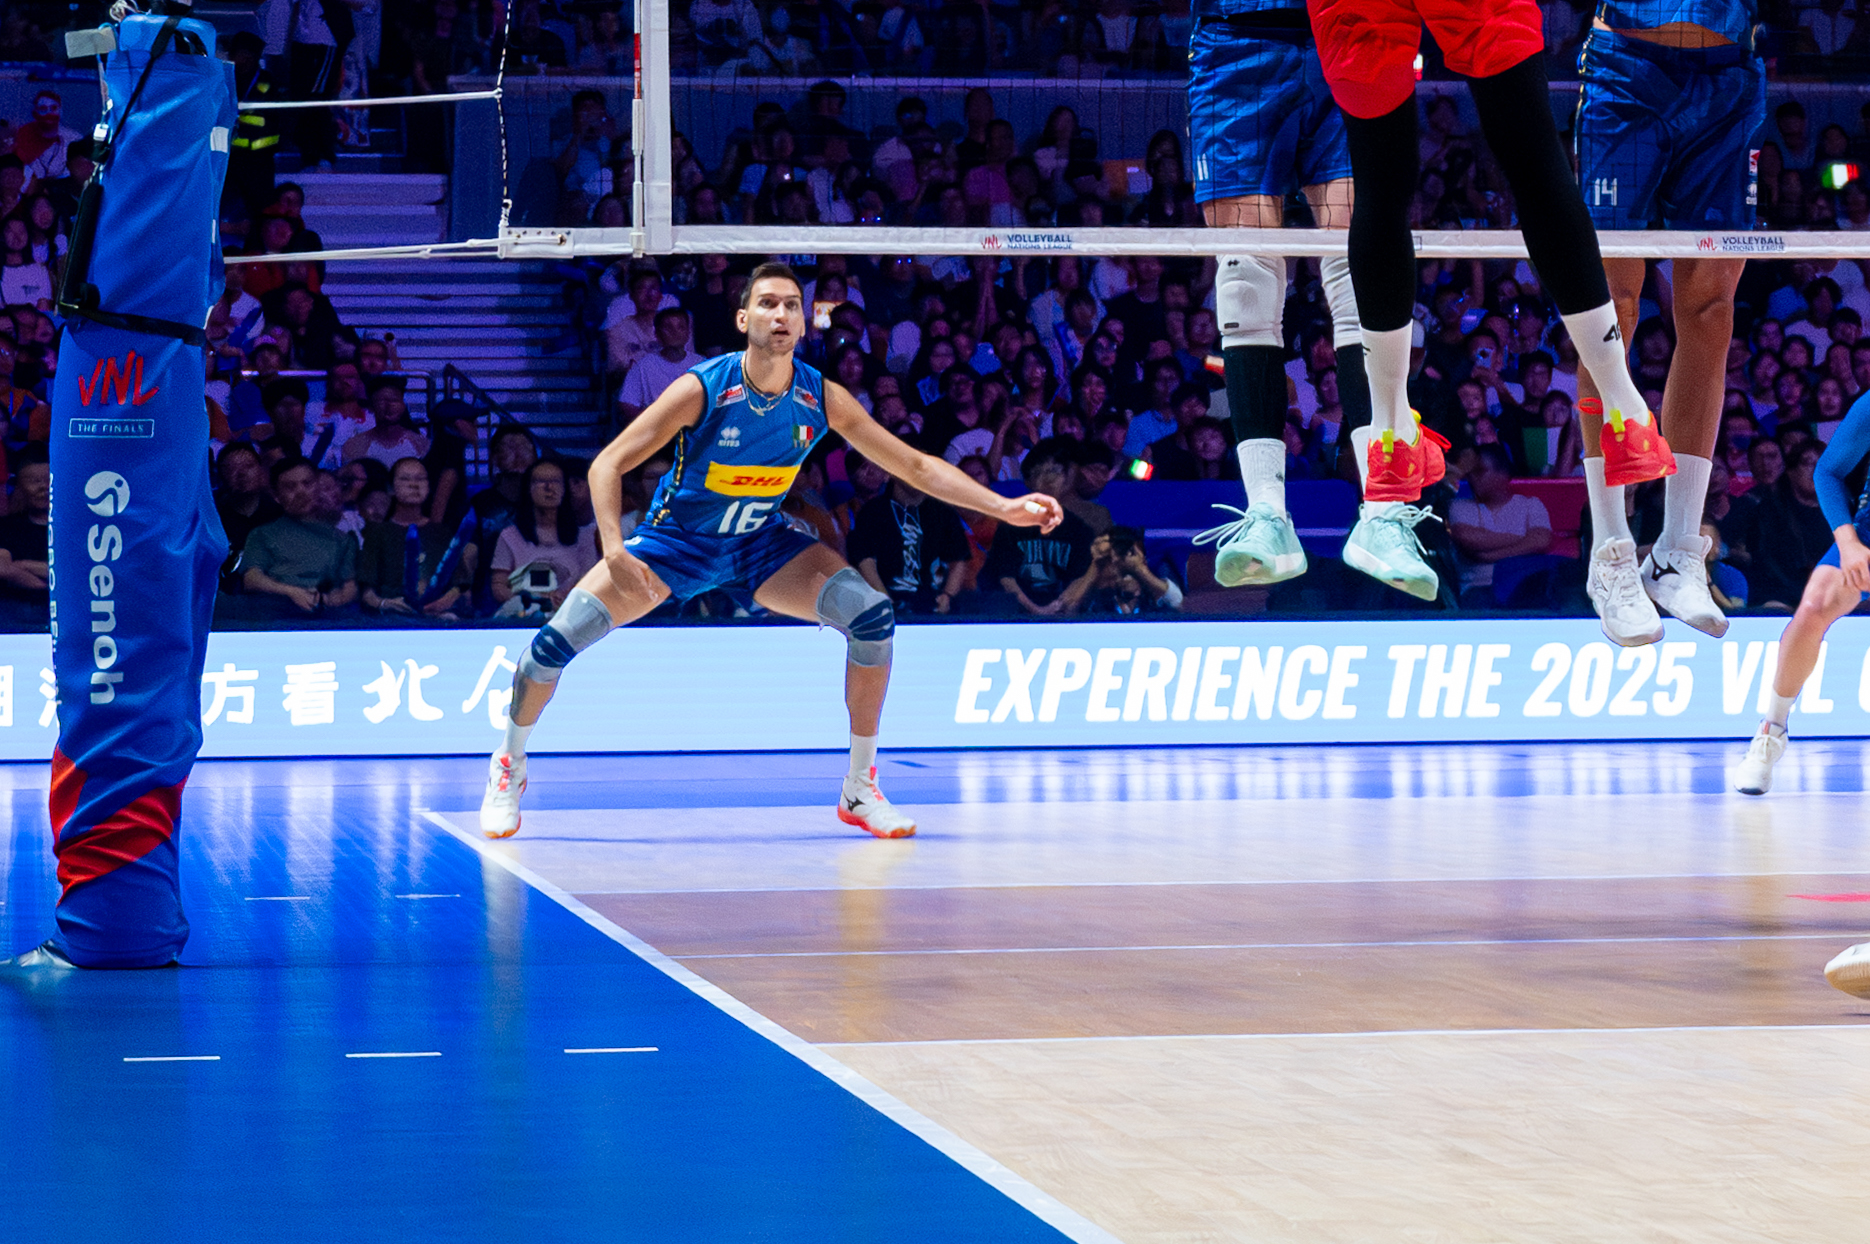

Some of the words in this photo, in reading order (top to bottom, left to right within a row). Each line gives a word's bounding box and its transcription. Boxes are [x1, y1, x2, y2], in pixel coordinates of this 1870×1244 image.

[1595, 178, 1617, 206] 14
[981, 234, 1002, 249] VNL
[1007, 234, 1072, 243] VOLLEYBALL
[1697, 236, 1718, 251] VNL
[1722, 236, 1784, 245] VOLLEYBALL
[78, 350, 159, 406] VNL
[77, 423, 97, 433] THE
[103, 423, 144, 433] FINALS
[731, 476, 785, 486] DHL
[718, 501, 775, 535] 16
[87, 523, 124, 706] Senoh
[955, 644, 1368, 724] EXPERIENCE
[1387, 643, 1510, 719] THE
[1523, 641, 1697, 719] 2025
